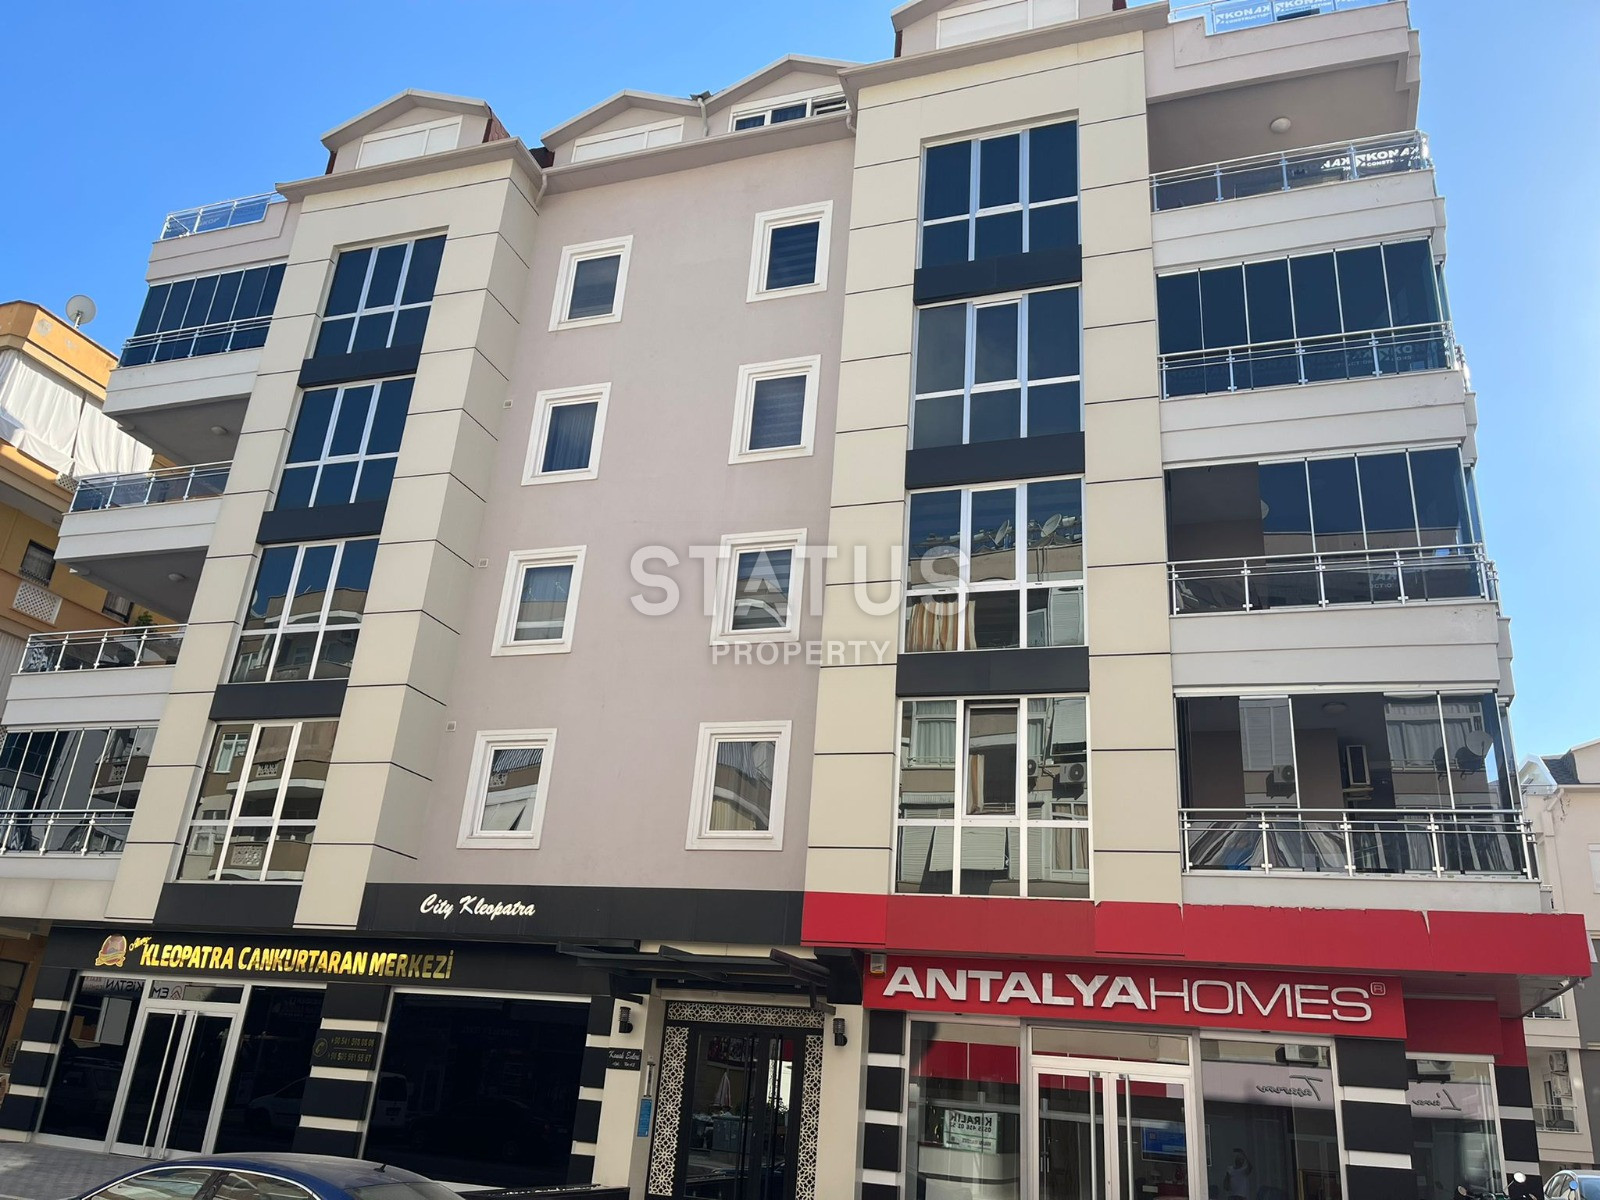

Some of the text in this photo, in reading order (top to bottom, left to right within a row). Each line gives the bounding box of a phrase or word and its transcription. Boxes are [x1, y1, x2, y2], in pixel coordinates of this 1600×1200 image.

[1225, 4, 1270, 19] KONAK
[420, 893, 536, 921] City Kleopatra
[140, 944, 454, 979] KLEOPATRA CANKURTARAN MERKEZİ
